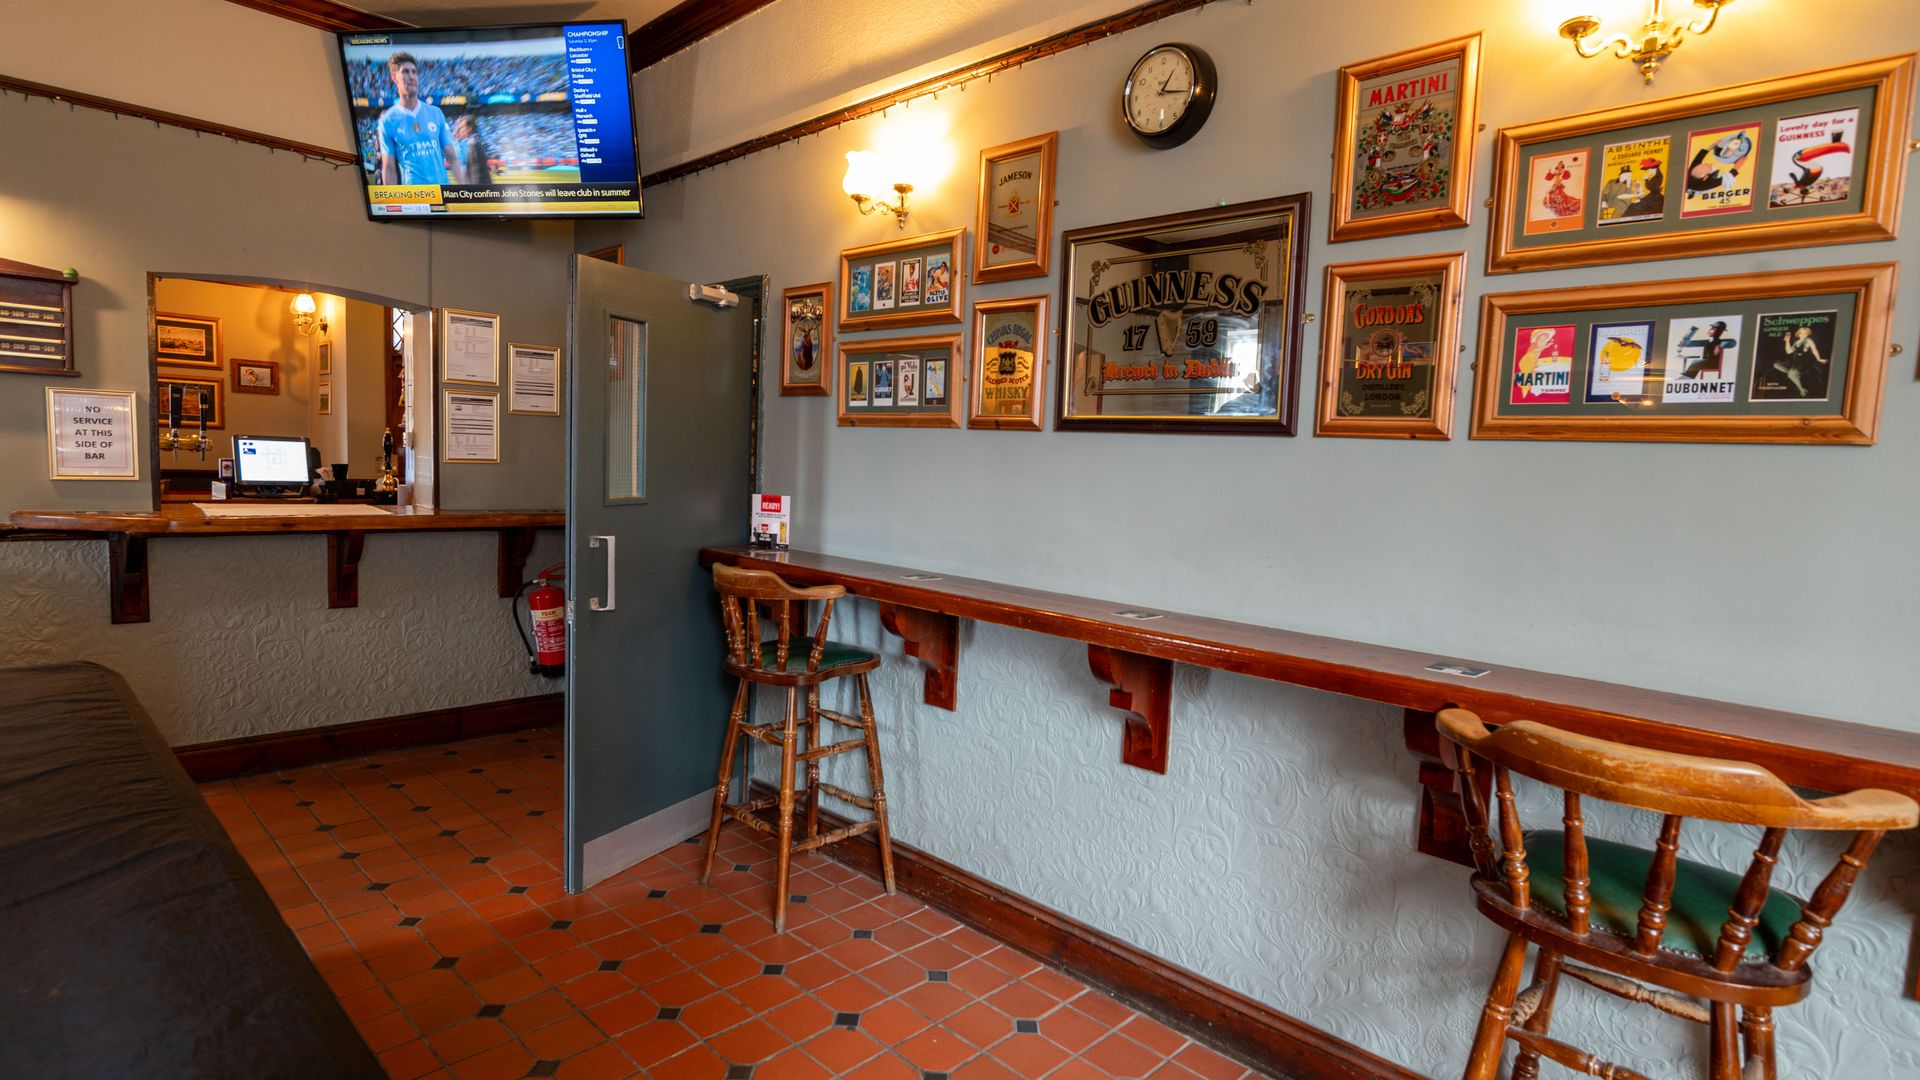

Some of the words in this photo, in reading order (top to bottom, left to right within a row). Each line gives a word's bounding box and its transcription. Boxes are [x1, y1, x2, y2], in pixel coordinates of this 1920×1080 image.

[1368, 72, 1448, 108] MARTINI
[1781, 124, 1809, 132] Lovely
[1779, 131, 1825, 142] GUINNESS
[1608, 139, 1670, 154] ABSINTHE
[999, 171, 1032, 187] JAMESON
[374, 191, 412, 199] BREAKING
[414, 190, 436, 199] NEWS
[443, 190, 459, 199] Man
[460, 190, 473, 200] City
[473, 190, 500, 199] confirm
[501, 190, 519, 198] John
[519, 189, 545, 198] Stones
[545, 189, 557, 197] will
[557, 189, 576, 197] leave
[577, 188, 593, 197] club
[593, 189, 600, 197] in
[601, 189, 631, 197] summer
[1702, 188, 1751, 200] BERGER
[927, 295, 948, 303] OLIVE
[1088, 270, 1267, 328] GUINNESS
[1354, 301, 1425, 329] GORDON'S
[1764, 316, 1830, 326] Schweppes
[1122, 325, 1150, 351] 17
[1186, 319, 1219, 348] 59
[1103, 361, 1159, 381] Brewed
[1162, 360, 1179, 379] in
[1356, 362, 1384, 380] DRY
[985, 375, 1008, 384] BLENDED
[1009, 373, 1030, 384] SCOTCH
[1515, 372, 1569, 386] MARTINI
[985, 386, 1028, 399] WHISKY
[1666, 382, 1734, 394] DUBONNET
[73, 417, 113, 425] SERVICE
[91, 429, 113, 437] THIS
[85, 452, 105, 460] BAR
[762, 501, 781, 510] READY!
